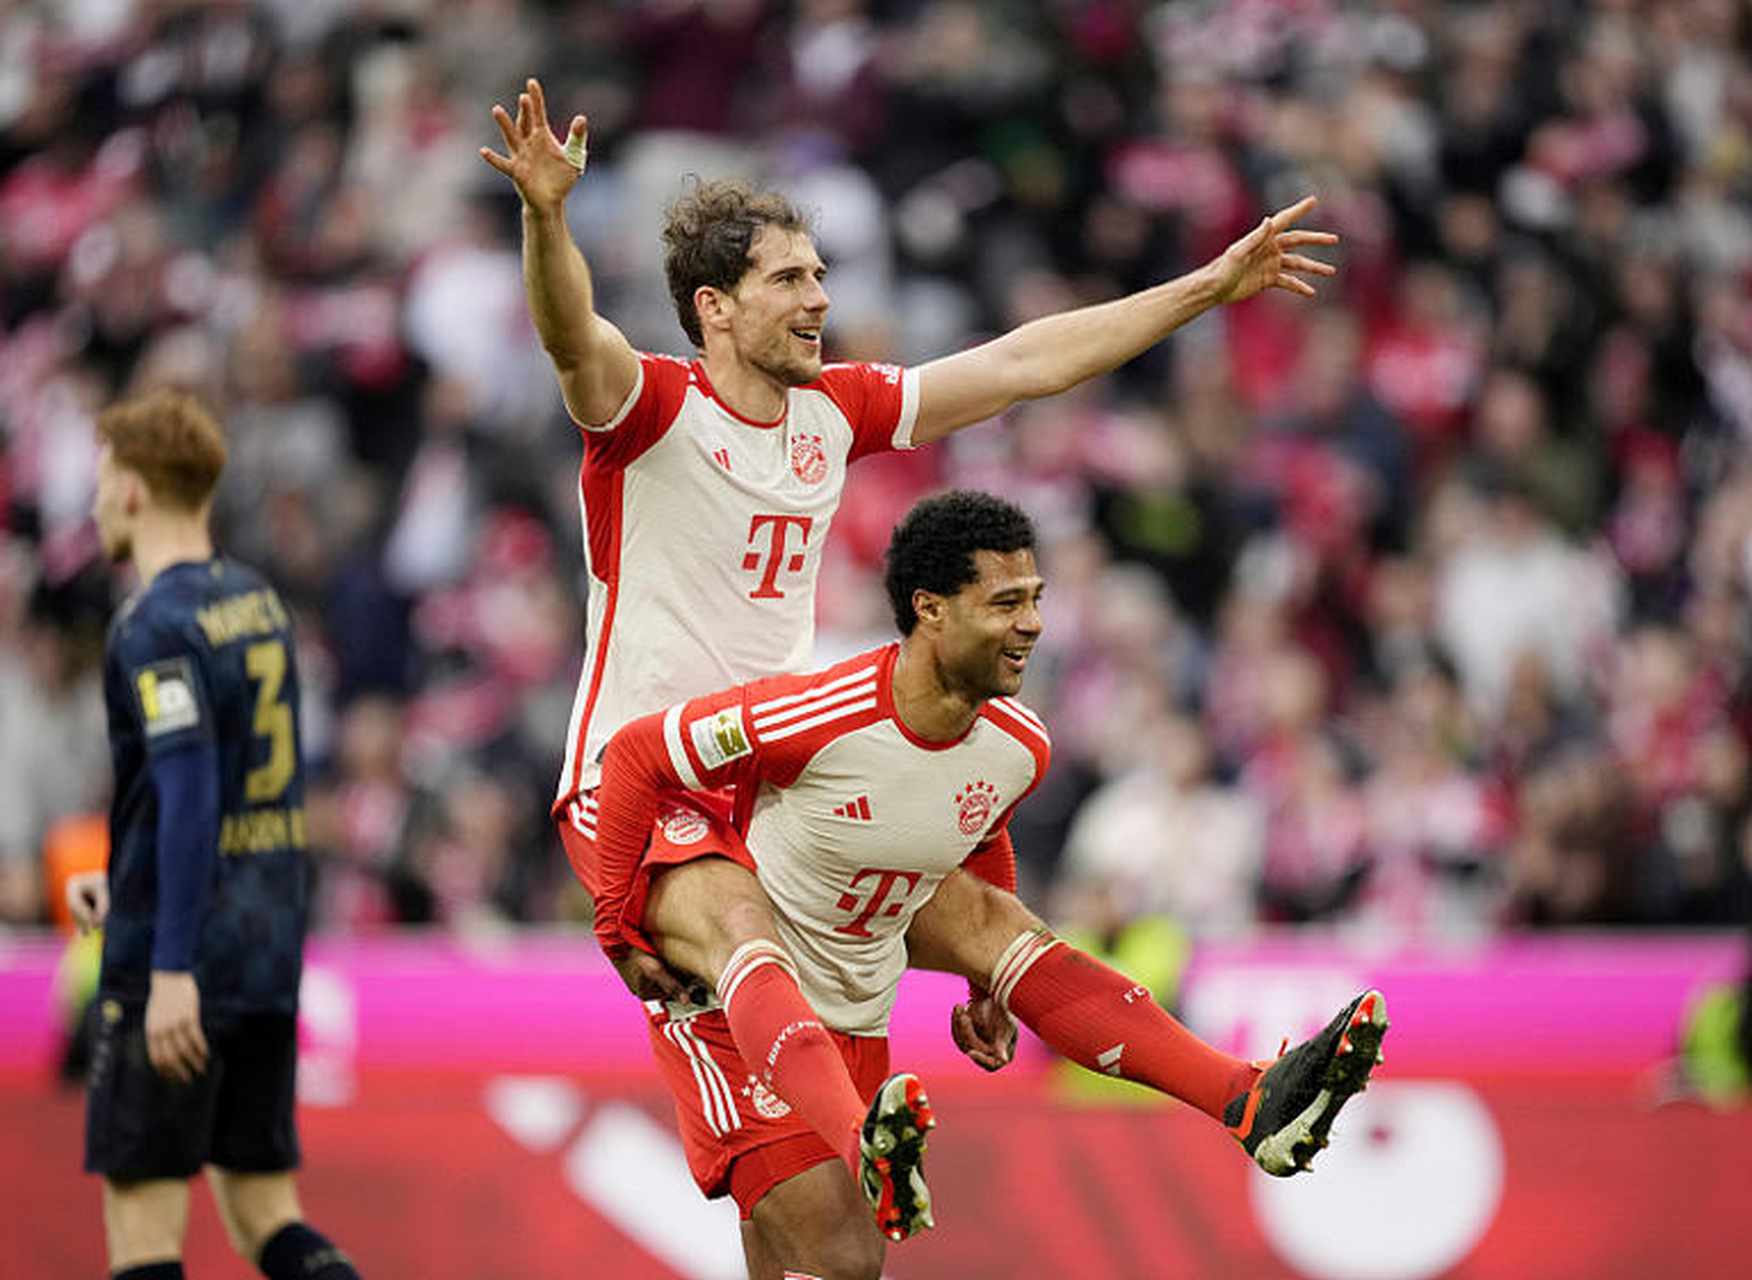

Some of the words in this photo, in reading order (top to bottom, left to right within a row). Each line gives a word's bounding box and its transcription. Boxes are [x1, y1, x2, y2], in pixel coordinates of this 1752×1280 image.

[742, 515, 813, 599] T
[245, 641, 295, 801] 3
[833, 868, 923, 938] T
